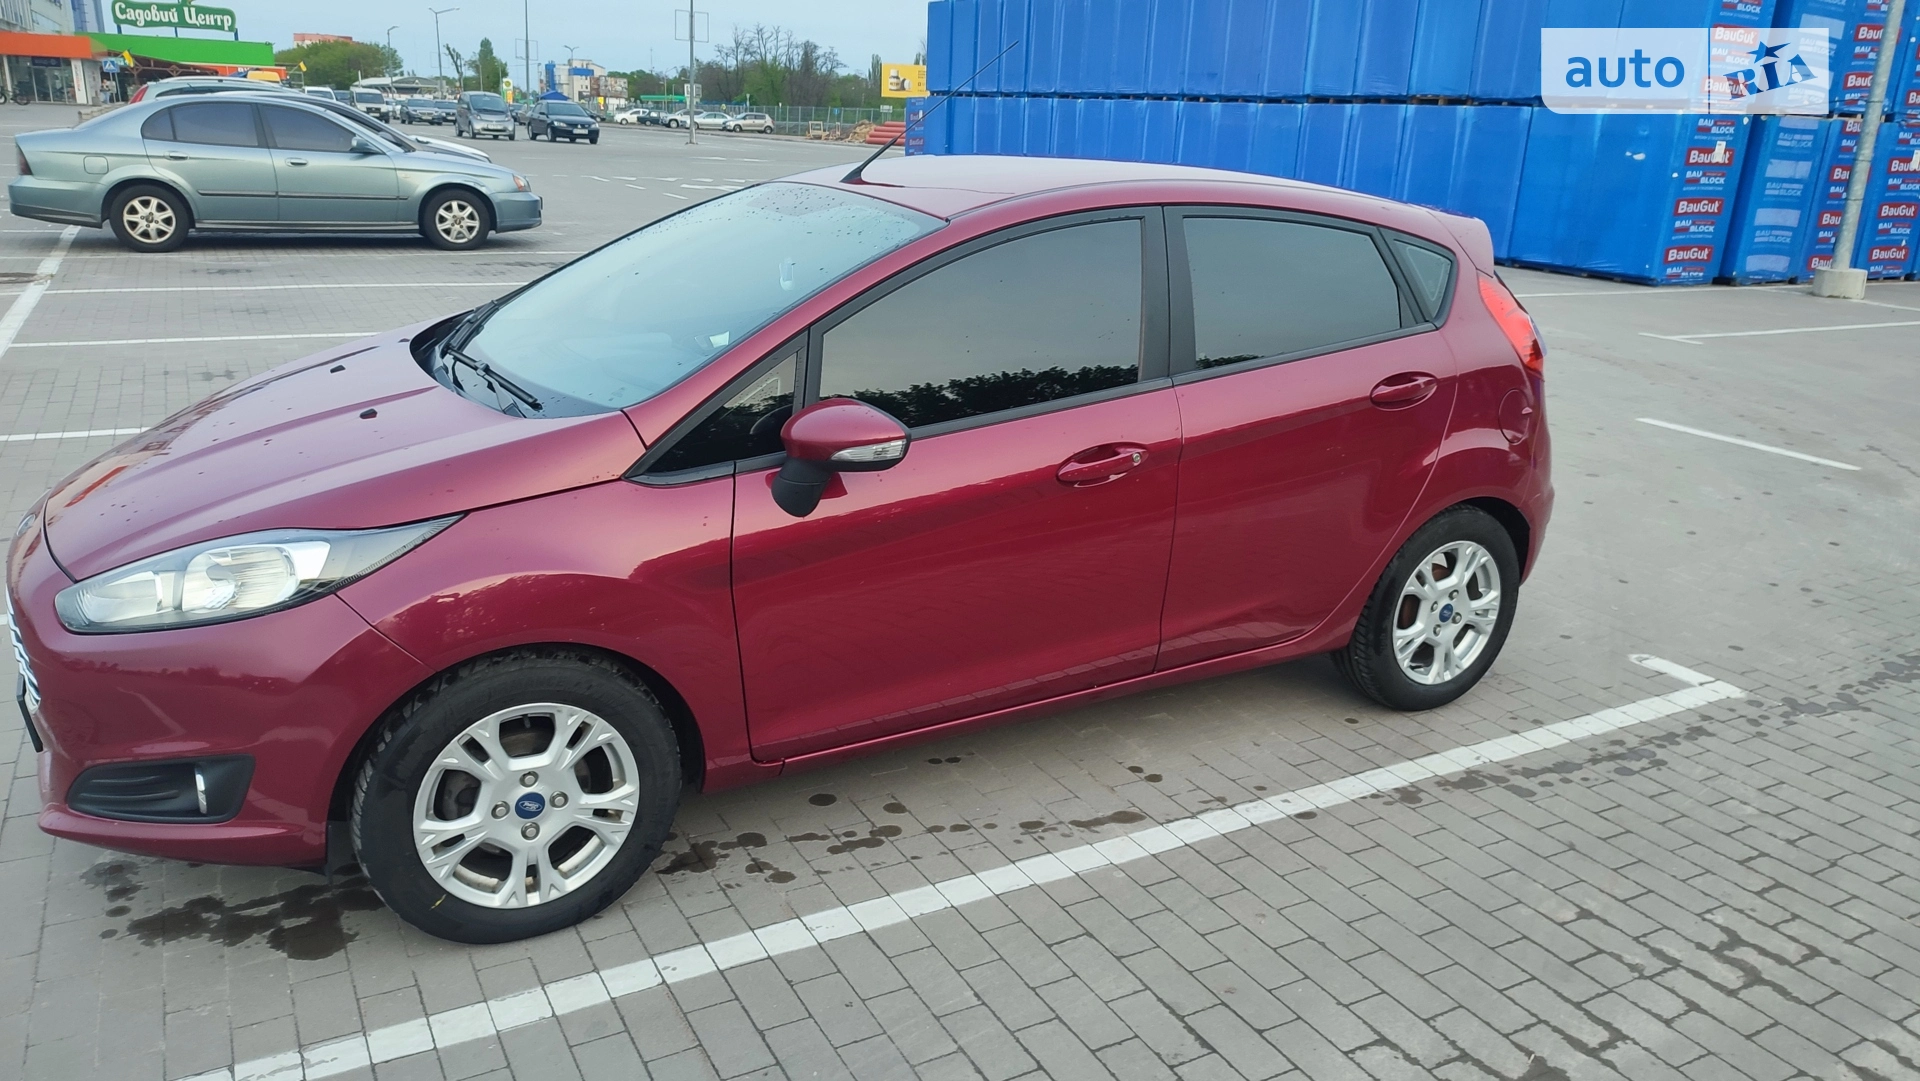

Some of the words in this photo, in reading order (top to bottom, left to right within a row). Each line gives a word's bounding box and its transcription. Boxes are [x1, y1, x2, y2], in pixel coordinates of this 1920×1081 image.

[115, 2, 178, 26] Садовий
[183, 7, 232, 31] Центр
[1858, 27, 1882, 38] Bau
[1847, 75, 1872, 87] Bau
[1677, 200, 1719, 213] BauGut
[1881, 205, 1914, 216] BauGut
[1822, 213, 1841, 224] Bau
[1667, 248, 1708, 261] BauGut
[1871, 248, 1904, 259] BauGut
